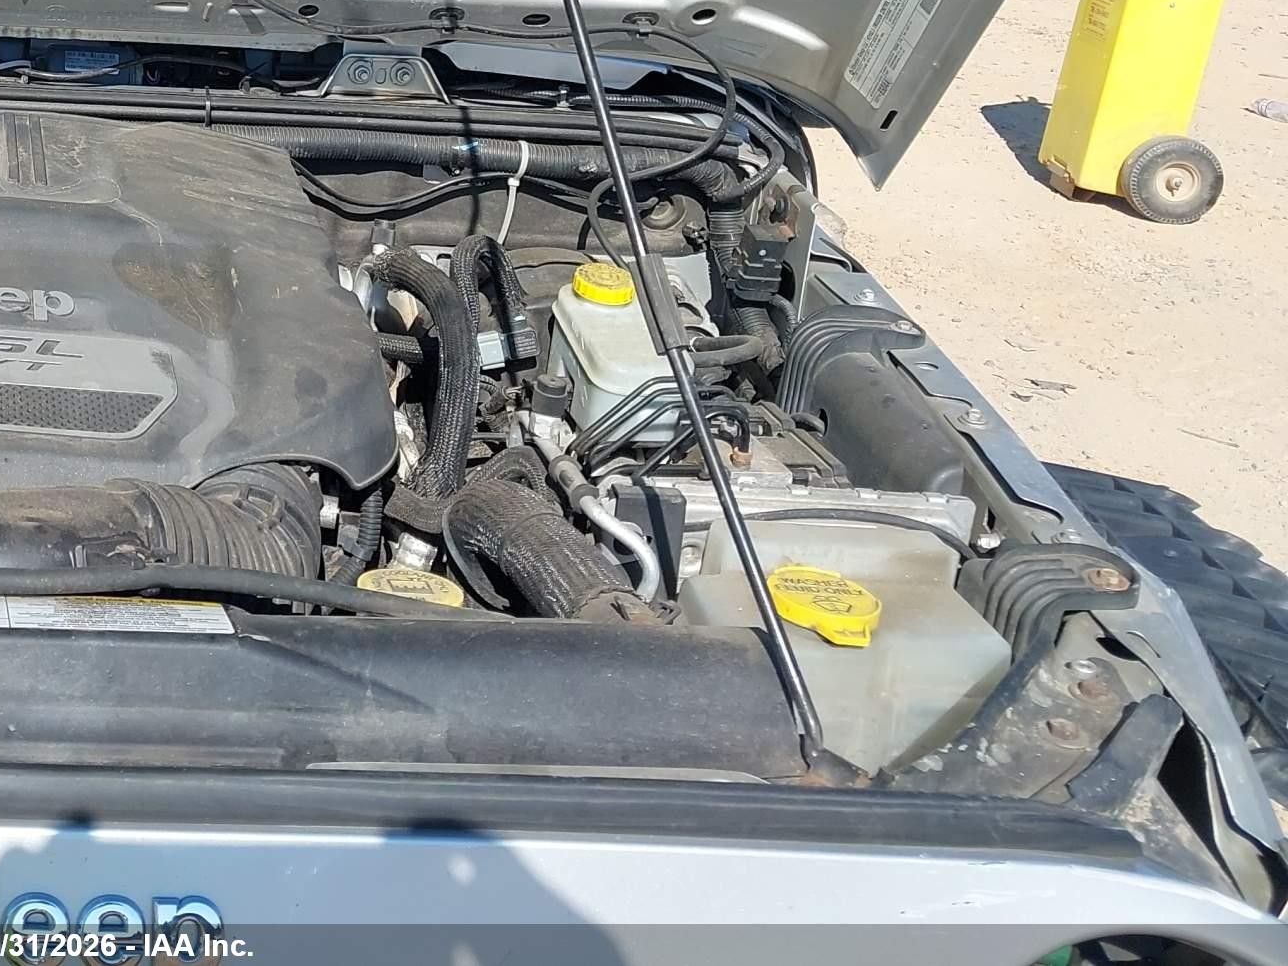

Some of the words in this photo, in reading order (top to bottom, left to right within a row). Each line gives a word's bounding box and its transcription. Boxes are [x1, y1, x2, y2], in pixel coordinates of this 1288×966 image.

[777, 577, 849, 588] WASHER
[774, 584, 820, 593] FLUID
[824, 586, 864, 595] ONLY
